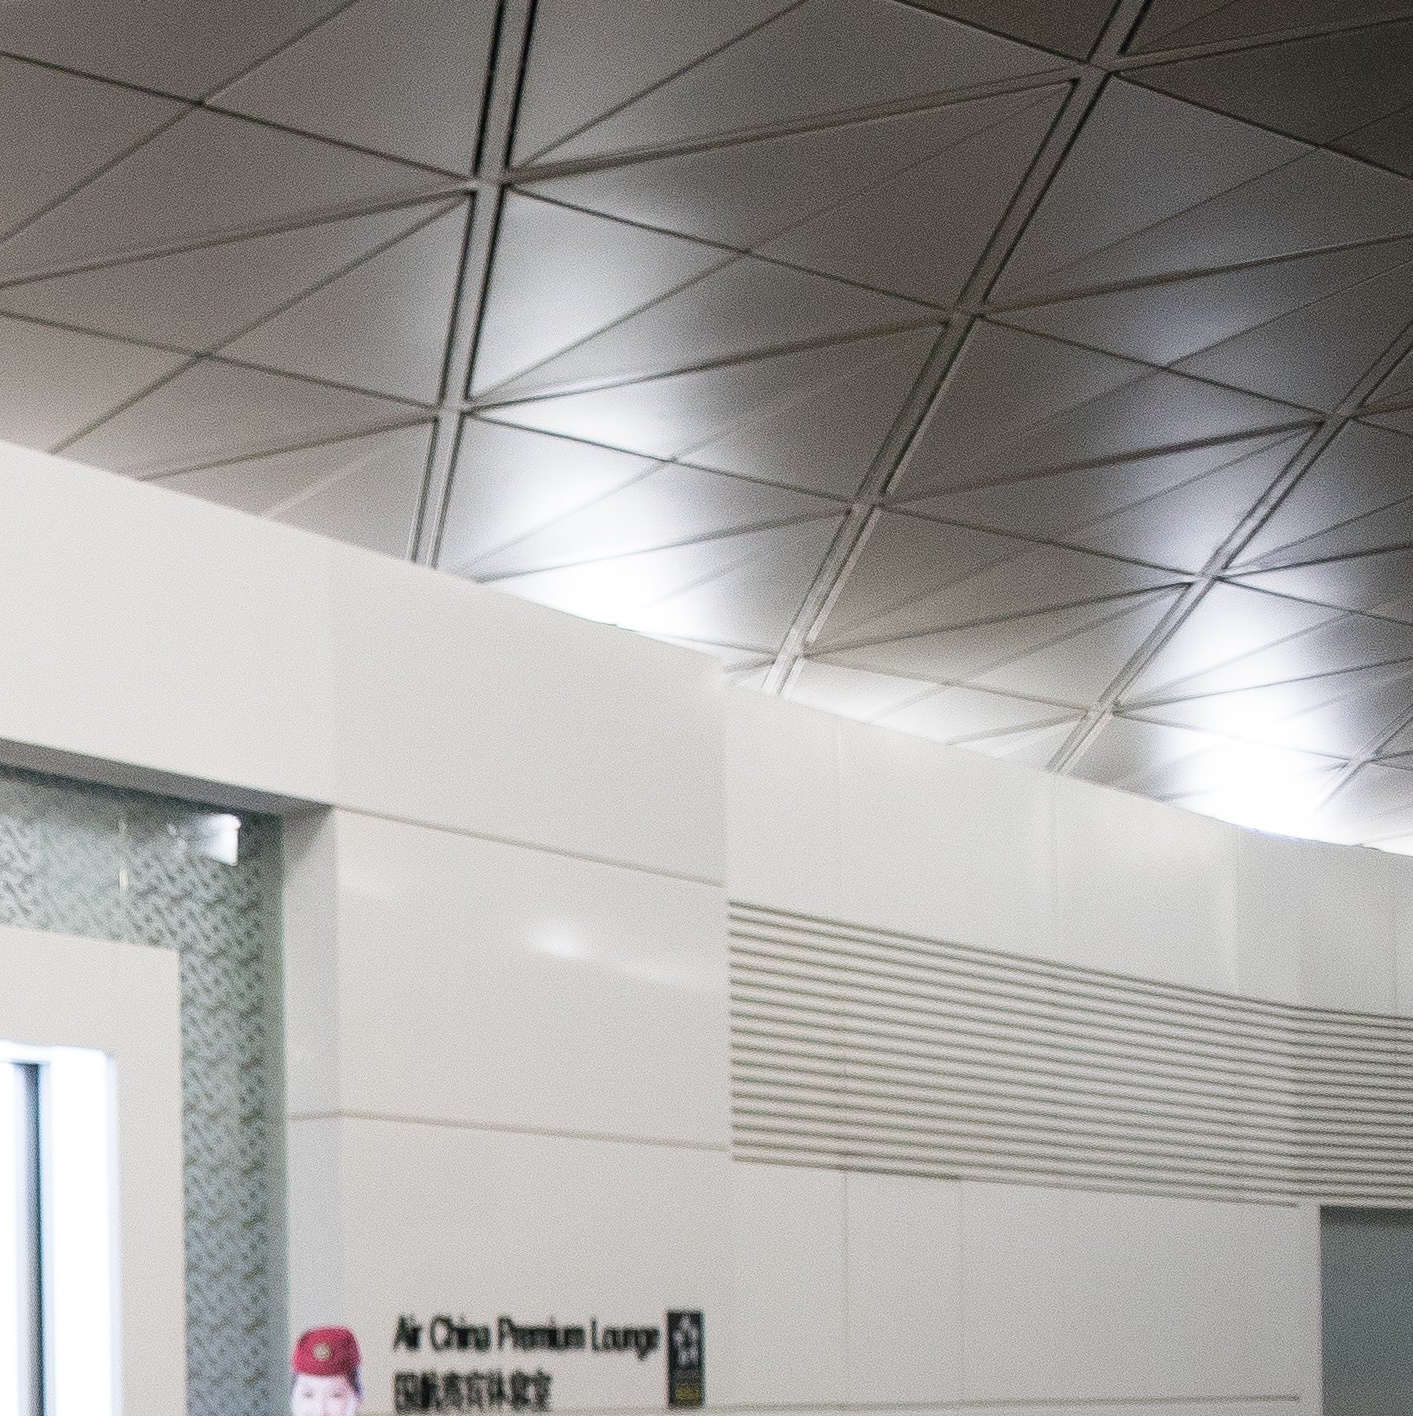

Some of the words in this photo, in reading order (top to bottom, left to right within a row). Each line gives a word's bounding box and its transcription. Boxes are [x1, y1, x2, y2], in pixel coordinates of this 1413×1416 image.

[392, 1313, 423, 1353] Air
[429, 1313, 493, 1353] China
[497, 1314, 588, 1353] Premium
[591, 1317, 661, 1362] Lounge
